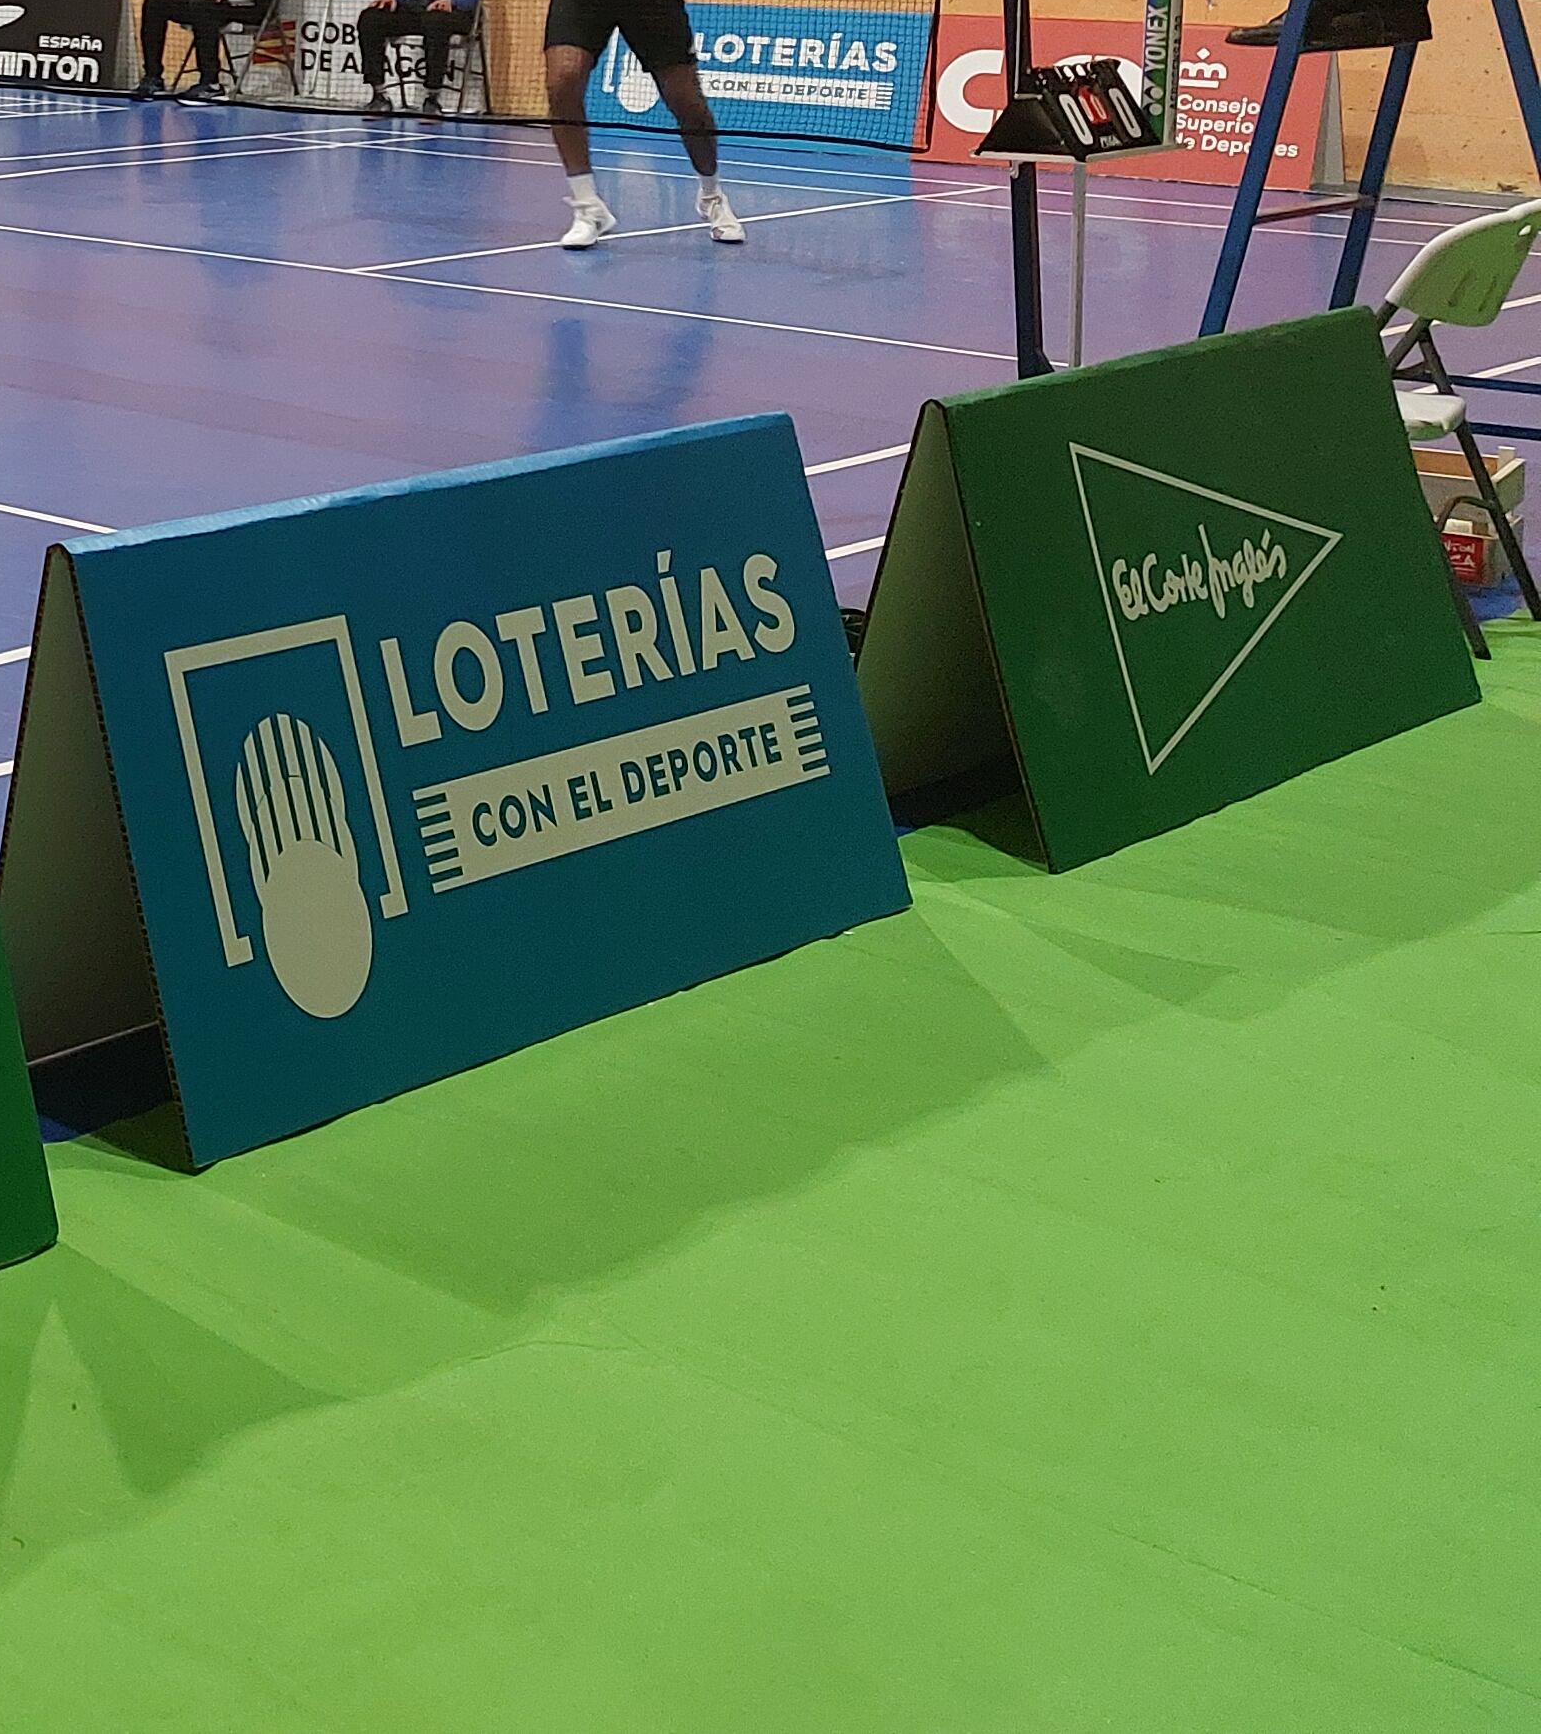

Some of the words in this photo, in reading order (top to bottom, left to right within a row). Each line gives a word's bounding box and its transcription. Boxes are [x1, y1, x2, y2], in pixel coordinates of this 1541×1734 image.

[39, 35, 103, 52] ESPAÑA
[694, 32, 898, 73] LOTERÍAS
[1144, 4, 1168, 73] YONEX
[710, 78, 749, 93] CON
[755, 81, 776, 94] EL
[781, 83, 868, 100] DEPORTE
[1177, 93, 1261, 117] Consejo
[1059, 93, 1094, 145] 0
[1108, 87, 1142, 138] 0
[1176, 113, 1254, 135] Superio
[1112, 559, 1150, 621] El
[1142, 553, 1209, 613] Corte
[1198, 523, 1287, 619] Inglés
[379, 550, 795, 747] LOTERÍAS
[471, 784, 557, 847] CON
[567, 771, 613, 821] EL
[620, 723, 782, 806] DEPORTE
